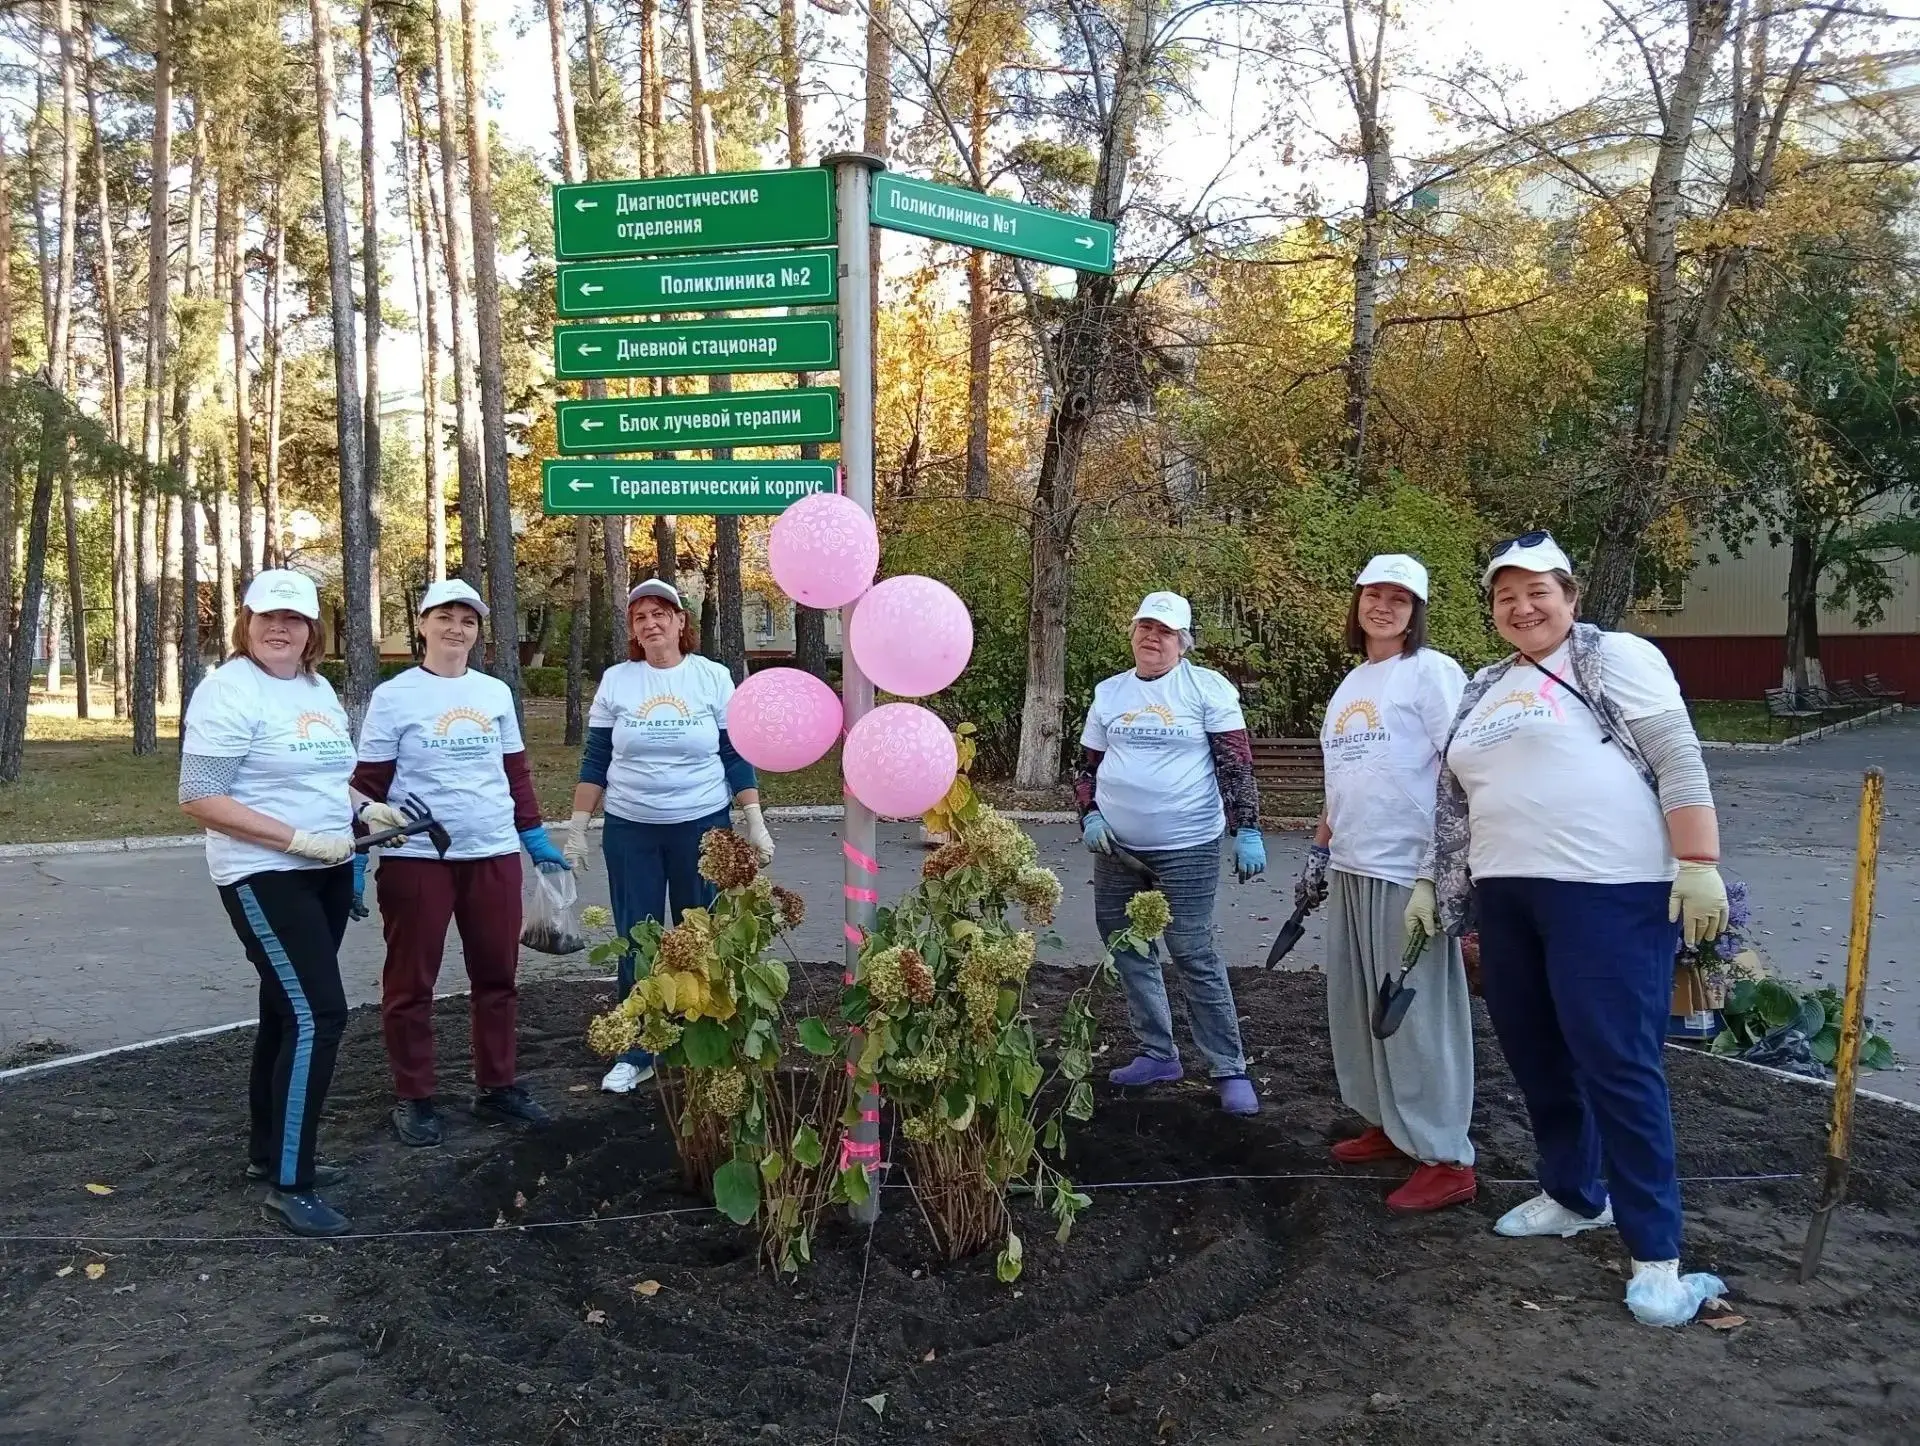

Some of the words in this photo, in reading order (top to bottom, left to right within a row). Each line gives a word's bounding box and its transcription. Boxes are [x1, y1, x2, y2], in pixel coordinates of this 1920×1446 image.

[616, 188, 759, 215] Диагностические
[890, 189, 989, 230] Поликлиника
[993, 214, 1017, 236] №1
[617, 218, 703, 240] отделения
[660, 272, 776, 295] Поликлиника
[780, 267, 811, 287] №2
[616, 336, 688, 361] Дневной
[692, 336, 778, 357] стационар
[619, 413, 659, 433] Блок
[663, 409, 731, 434] лучевой
[734, 408, 802, 428] терапии
[610, 475, 760, 499] Терапевтический
[765, 479, 824, 499] корпус
